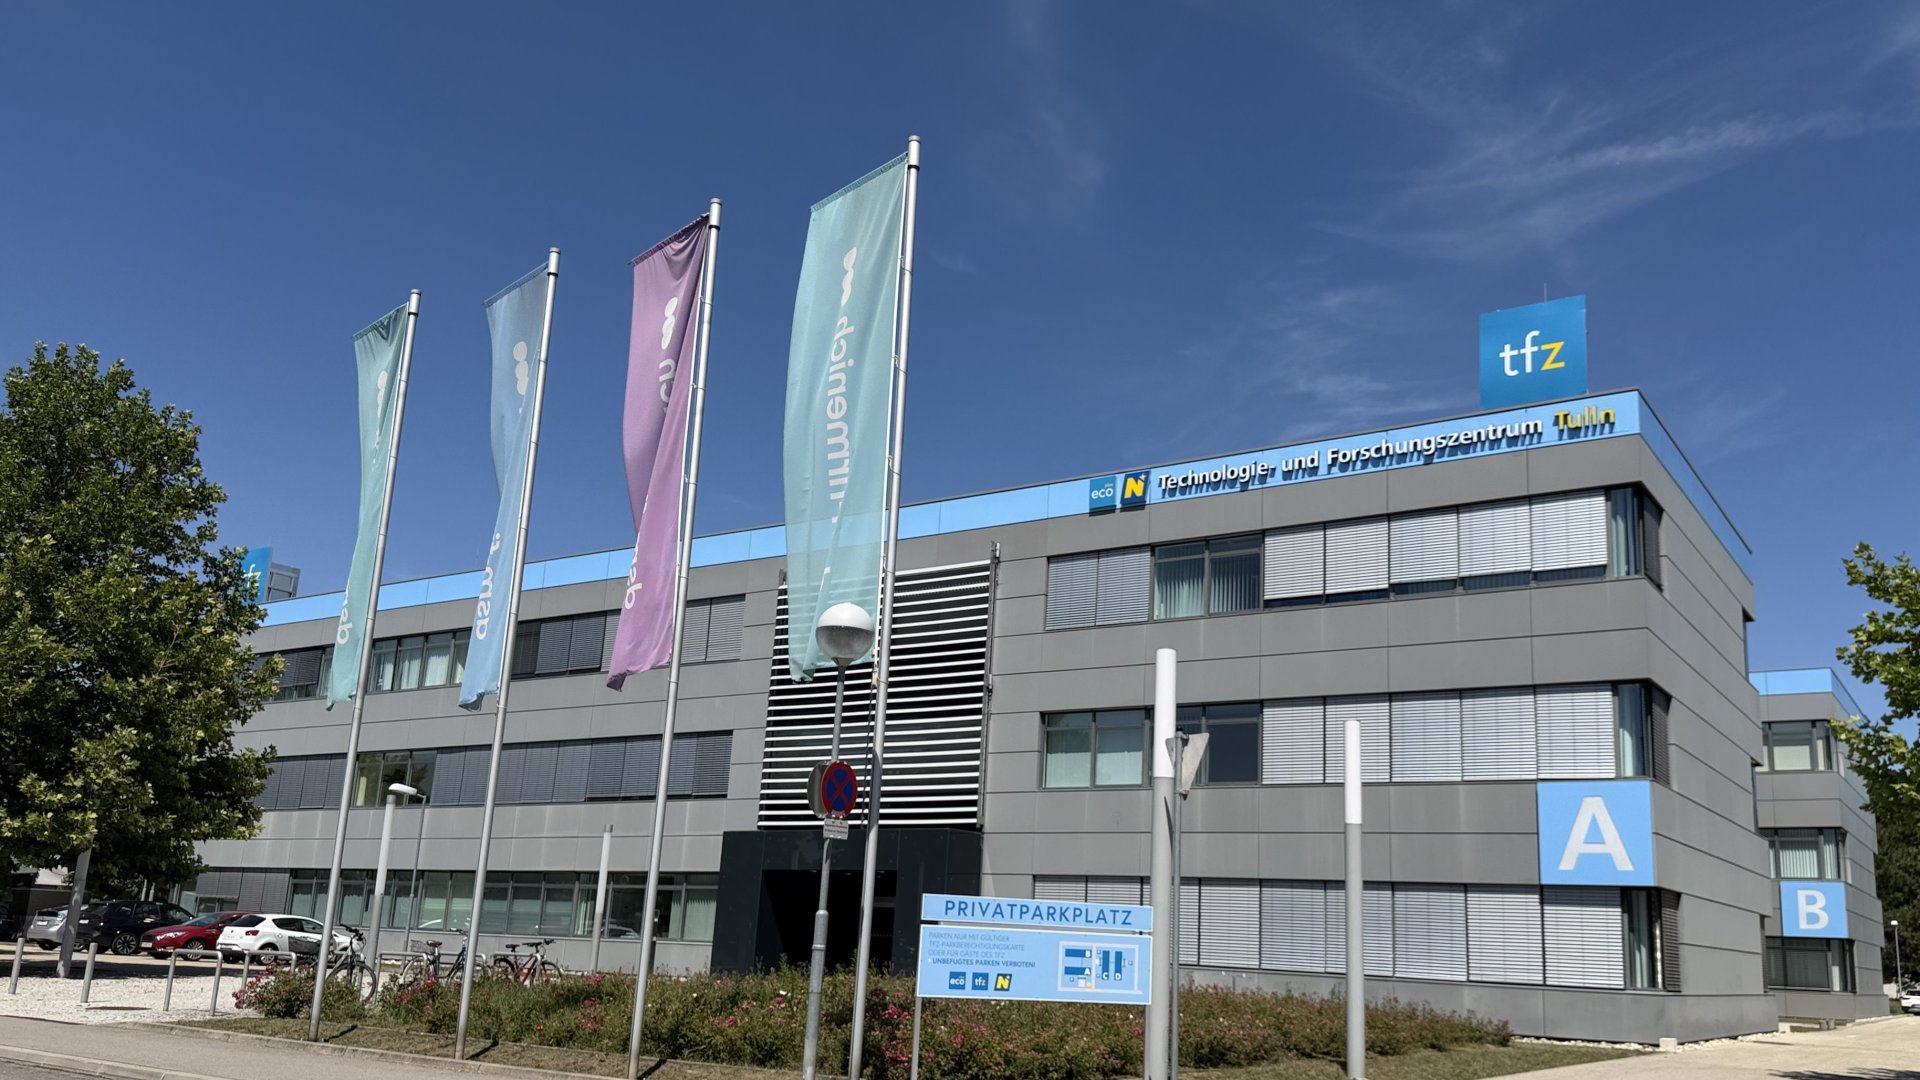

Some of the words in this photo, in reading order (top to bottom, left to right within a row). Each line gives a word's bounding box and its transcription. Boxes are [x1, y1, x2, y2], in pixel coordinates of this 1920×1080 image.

[1499, 330, 1565, 376] tfz
[1158, 460, 1276, 490] Technologie-
[1282, 450, 1319, 472] und
[1327, 418, 1543, 465] Forschungszentrum
[1554, 404, 1616, 430] Tulln
[1091, 487, 1114, 500] eco
[1558, 796, 1635, 871] A
[944, 900, 1133, 926] PRIVATPARKPLATZ
[1797, 889, 1830, 930] B
[928, 949, 946, 957] ODER
[932, 958, 974, 966] UNBEFUGTES
[975, 959, 1000, 967] PARKEN
[1001, 960, 1036, 968] VERBOTEN!
[1084, 967, 1091, 976] A
[974, 976, 986, 985] tfz
